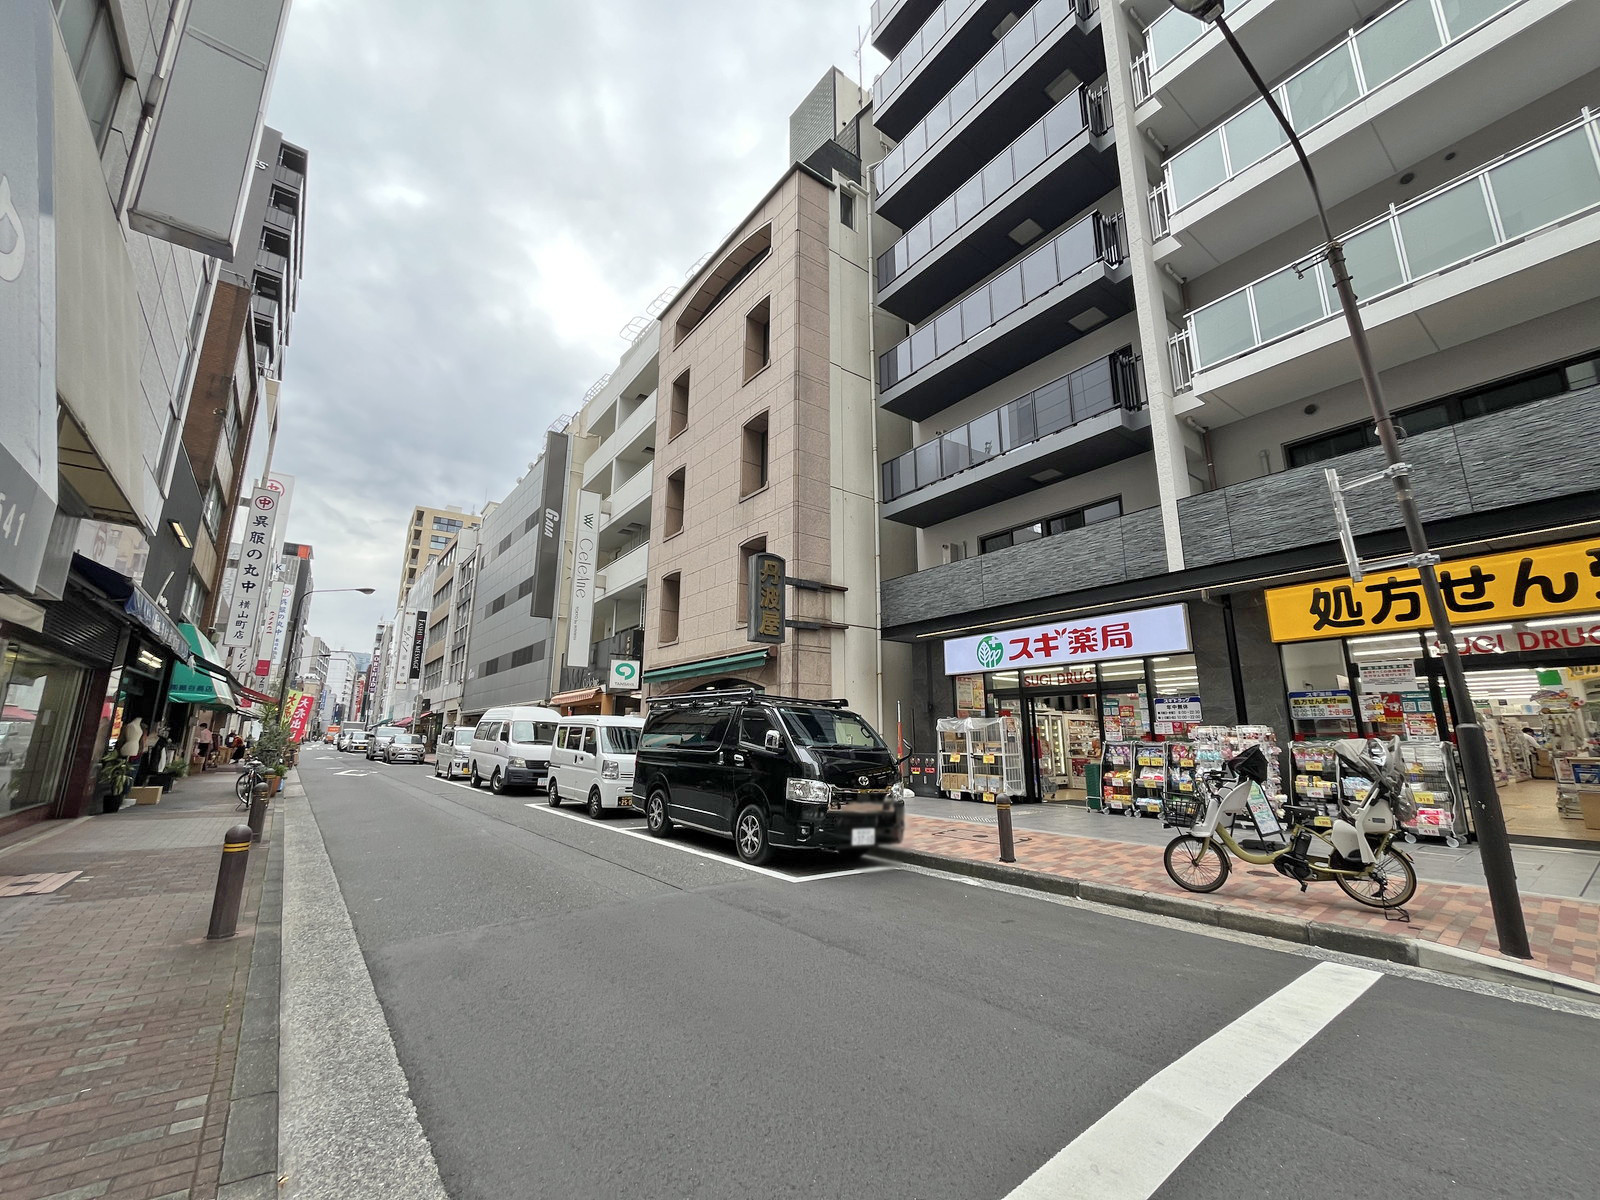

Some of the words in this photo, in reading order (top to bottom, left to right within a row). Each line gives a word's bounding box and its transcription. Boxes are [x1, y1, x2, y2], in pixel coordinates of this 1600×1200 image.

[544, 507, 560, 538] GAIA
[242, 515, 269, 594] 呉服の丸中
[760, 560, 781, 636] 丹波屋
[233, 600, 251, 640] 横山町店
[1008, 622, 1133, 661] スギ薬局
[1434, 634, 1505, 656] UGI
[1024, 673, 1052, 687] SUGI
[1057, 671, 1094, 684] DRUG
